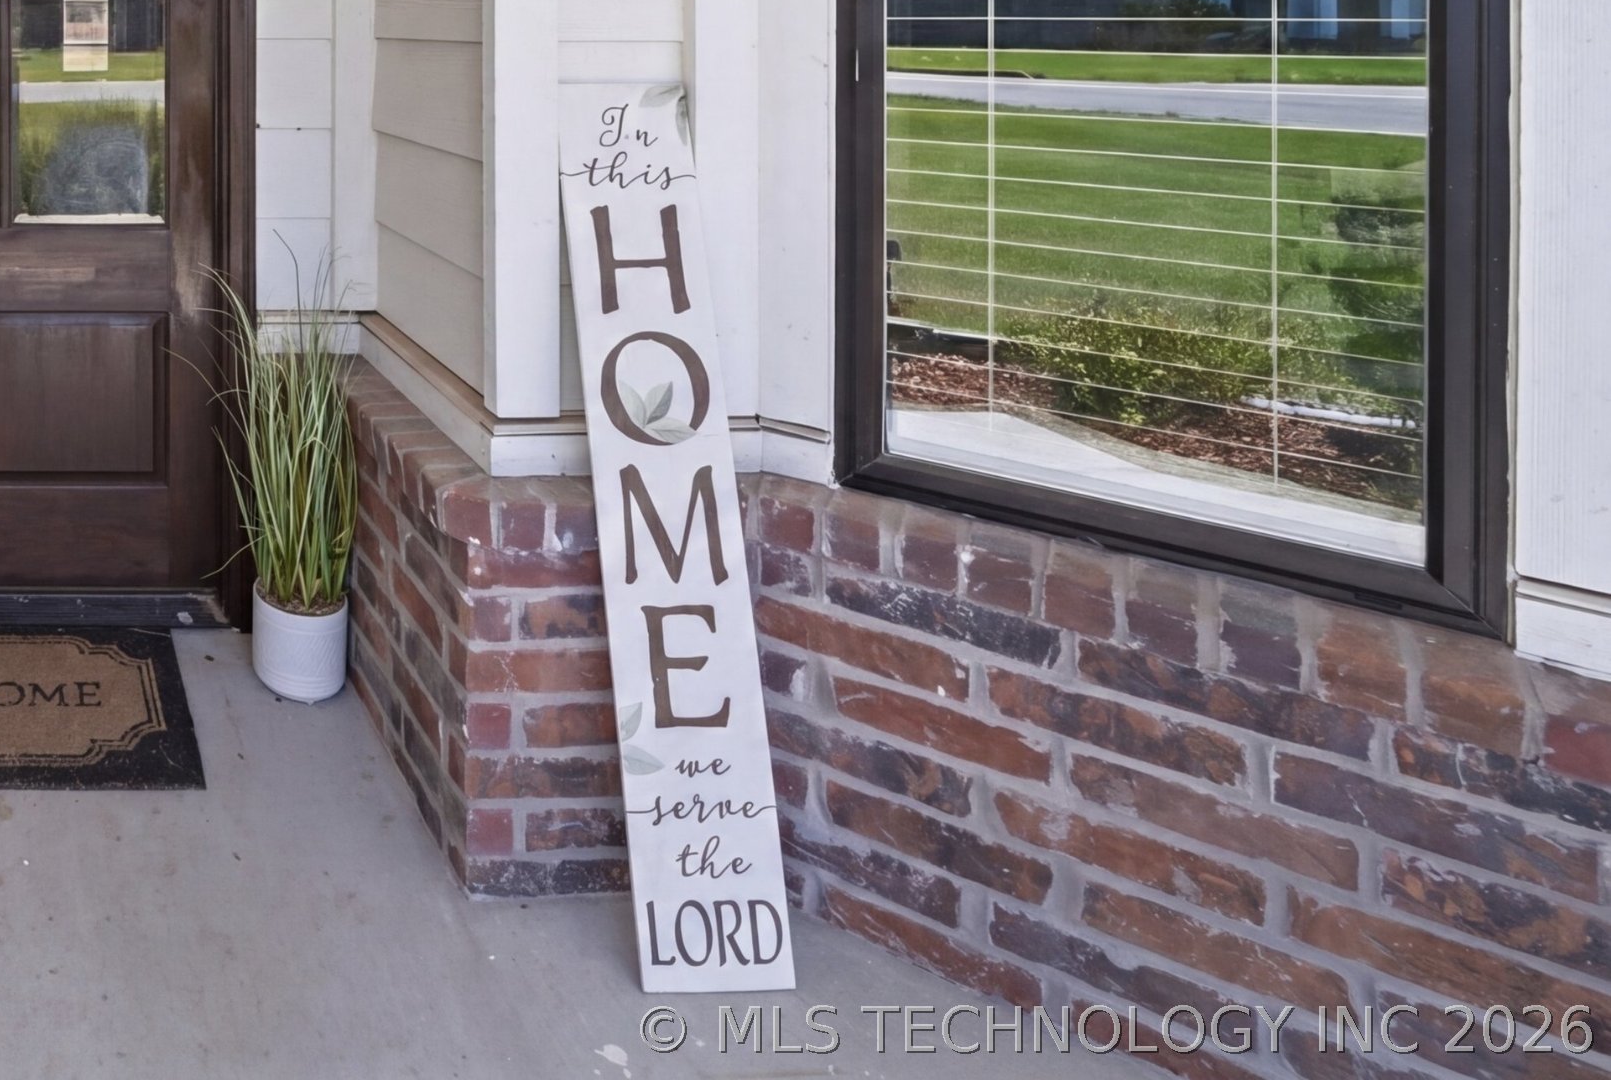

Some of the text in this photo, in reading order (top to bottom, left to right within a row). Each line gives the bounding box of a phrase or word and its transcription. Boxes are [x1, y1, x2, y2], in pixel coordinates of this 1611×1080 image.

[599, 103, 658, 148] In
[559, 151, 696, 190] this
[590, 203, 731, 729] HOME
[674, 755, 732, 777] we
[625, 793, 779, 827] serve
[674, 834, 753, 879] the
[646, 899, 784, 968] LORD
